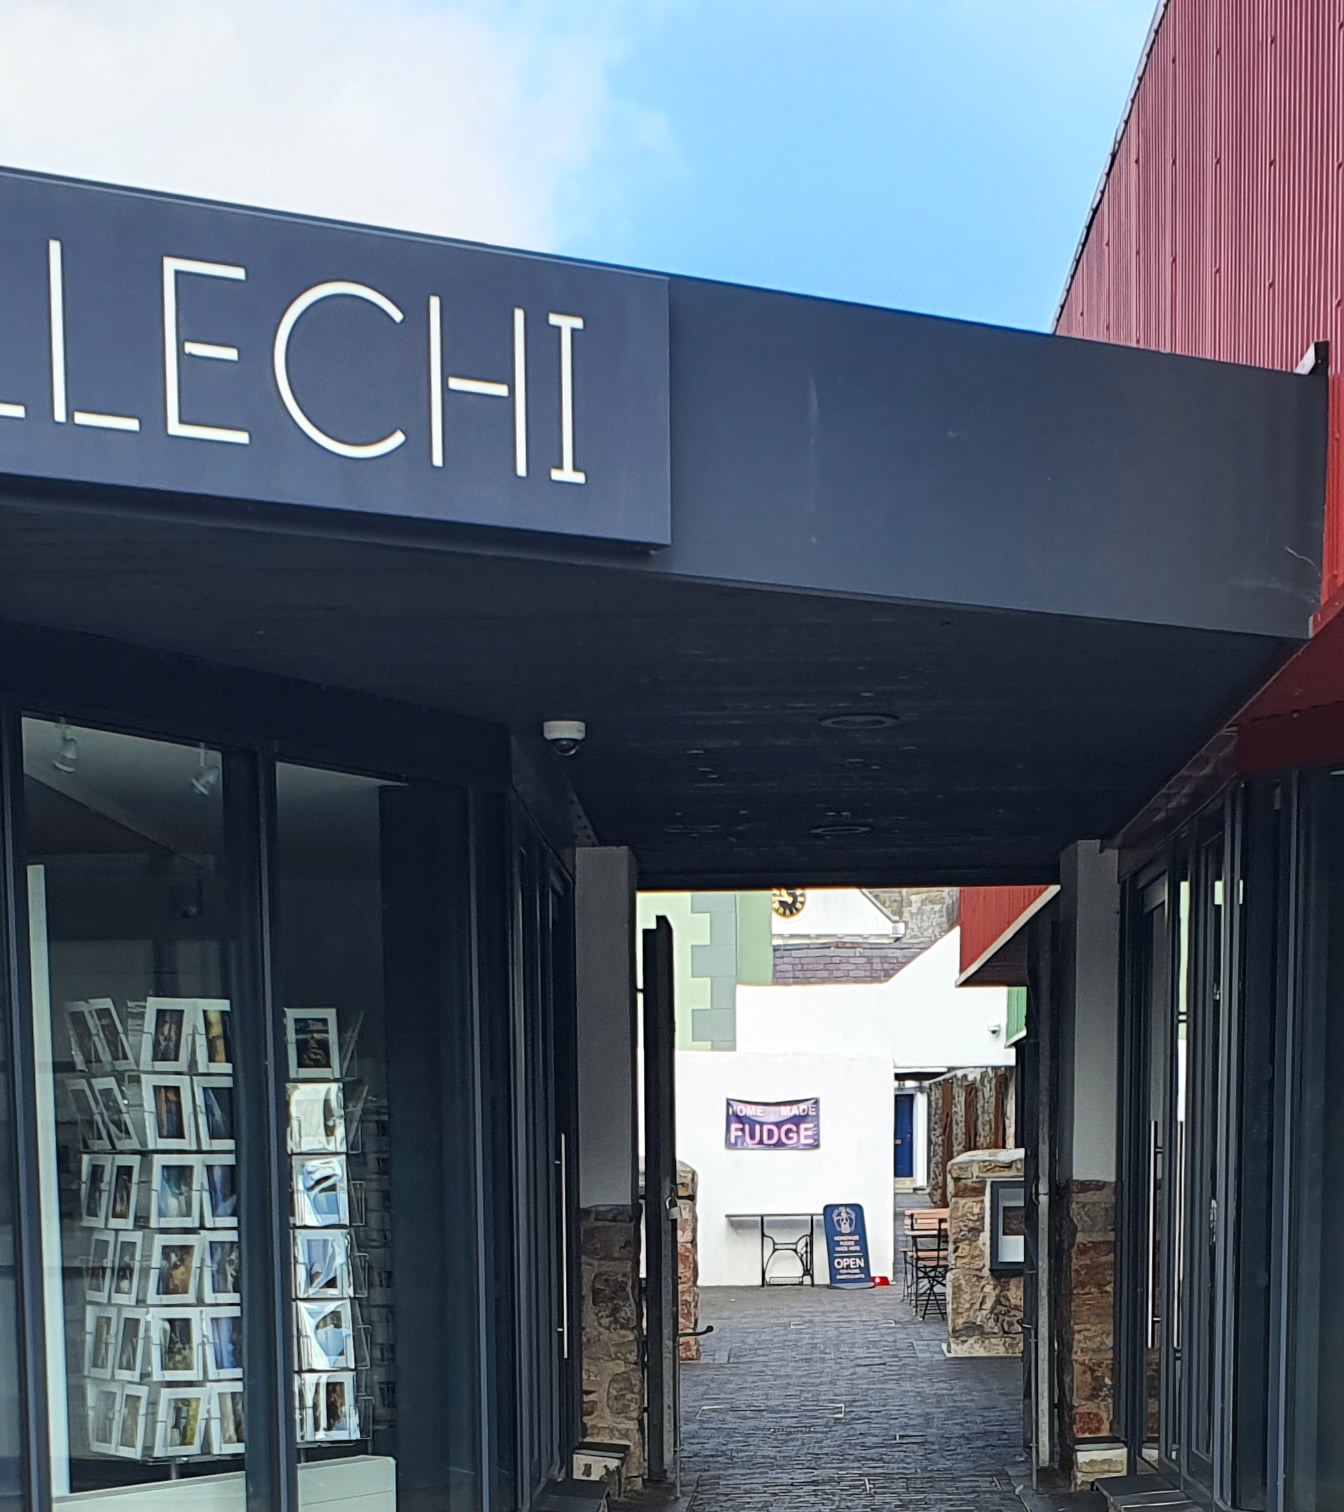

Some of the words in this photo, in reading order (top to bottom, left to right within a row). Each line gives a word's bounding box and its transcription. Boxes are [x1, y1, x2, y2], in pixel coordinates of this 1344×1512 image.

[729, 1104, 765, 1117] HOME
[780, 1104, 817, 1117] MADE
[730, 1122, 815, 1145] FUDGE
[834, 1257, 865, 1269] OPEN
